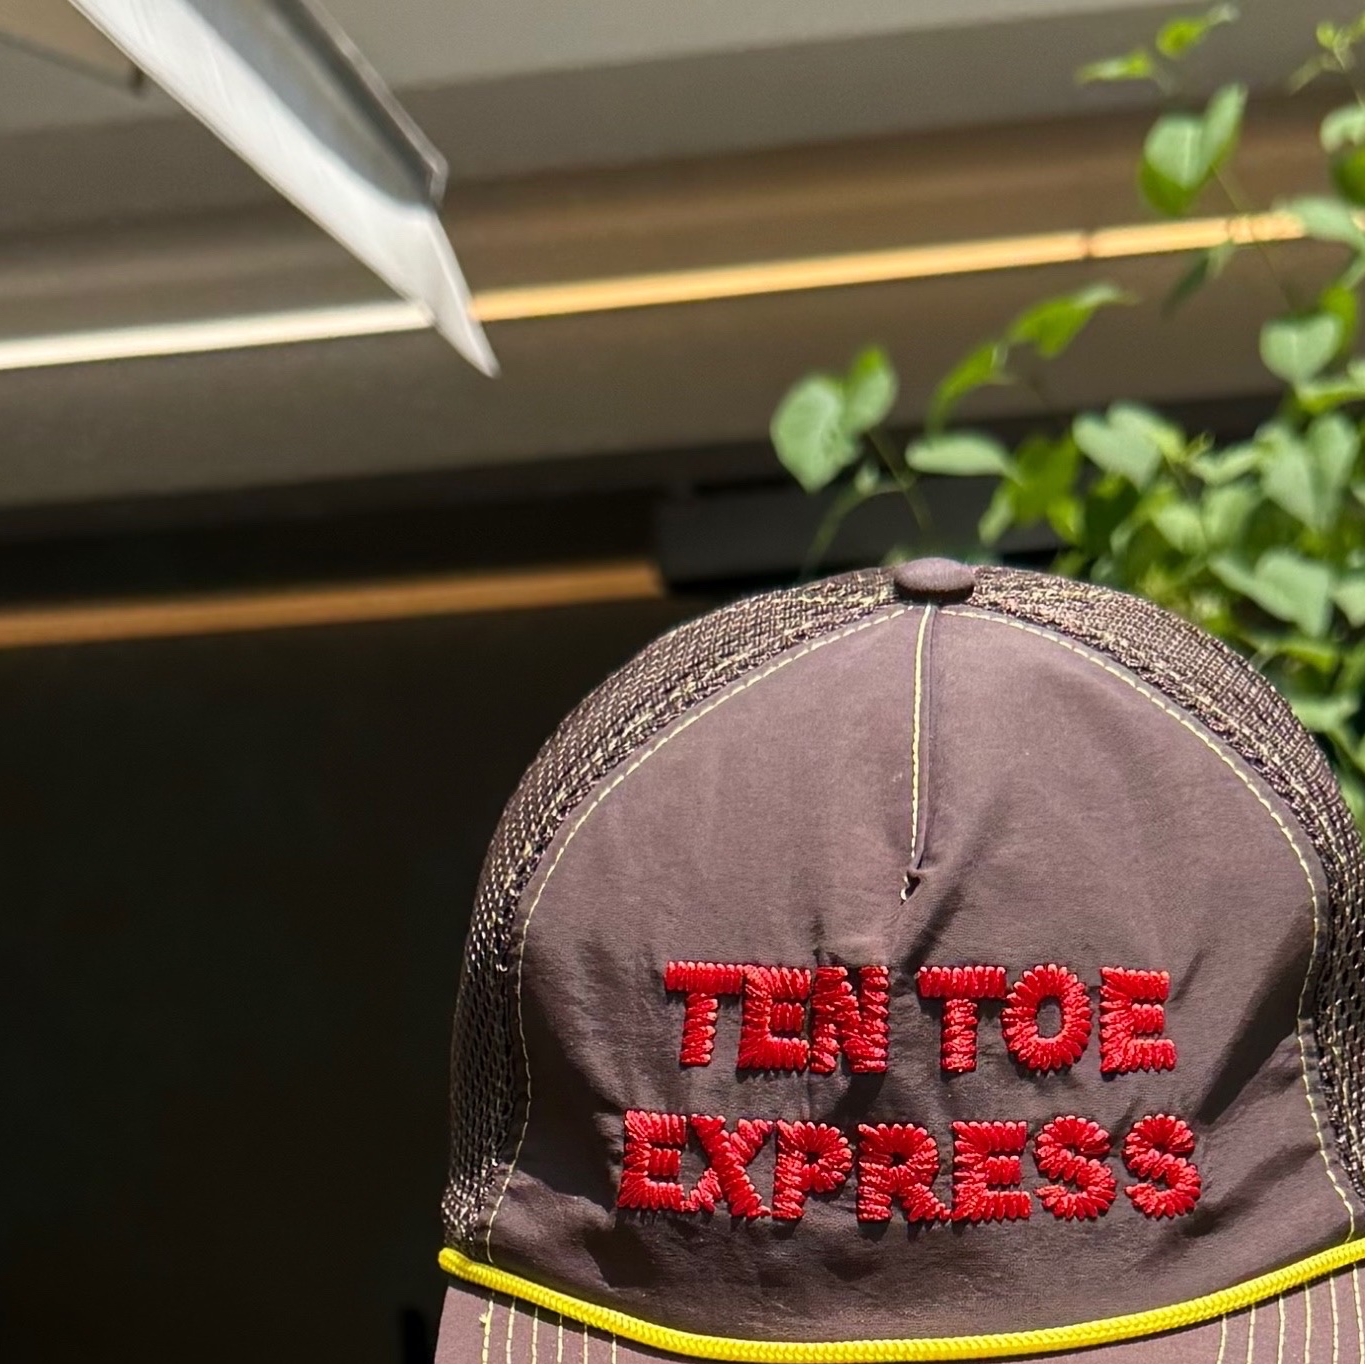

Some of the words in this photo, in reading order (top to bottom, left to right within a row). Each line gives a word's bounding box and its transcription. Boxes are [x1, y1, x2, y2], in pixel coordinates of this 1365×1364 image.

[664, 961, 890, 1075] TEN
[917, 964, 1178, 1074] TOE
[617, 1109, 1202, 1223] EXPRESS
